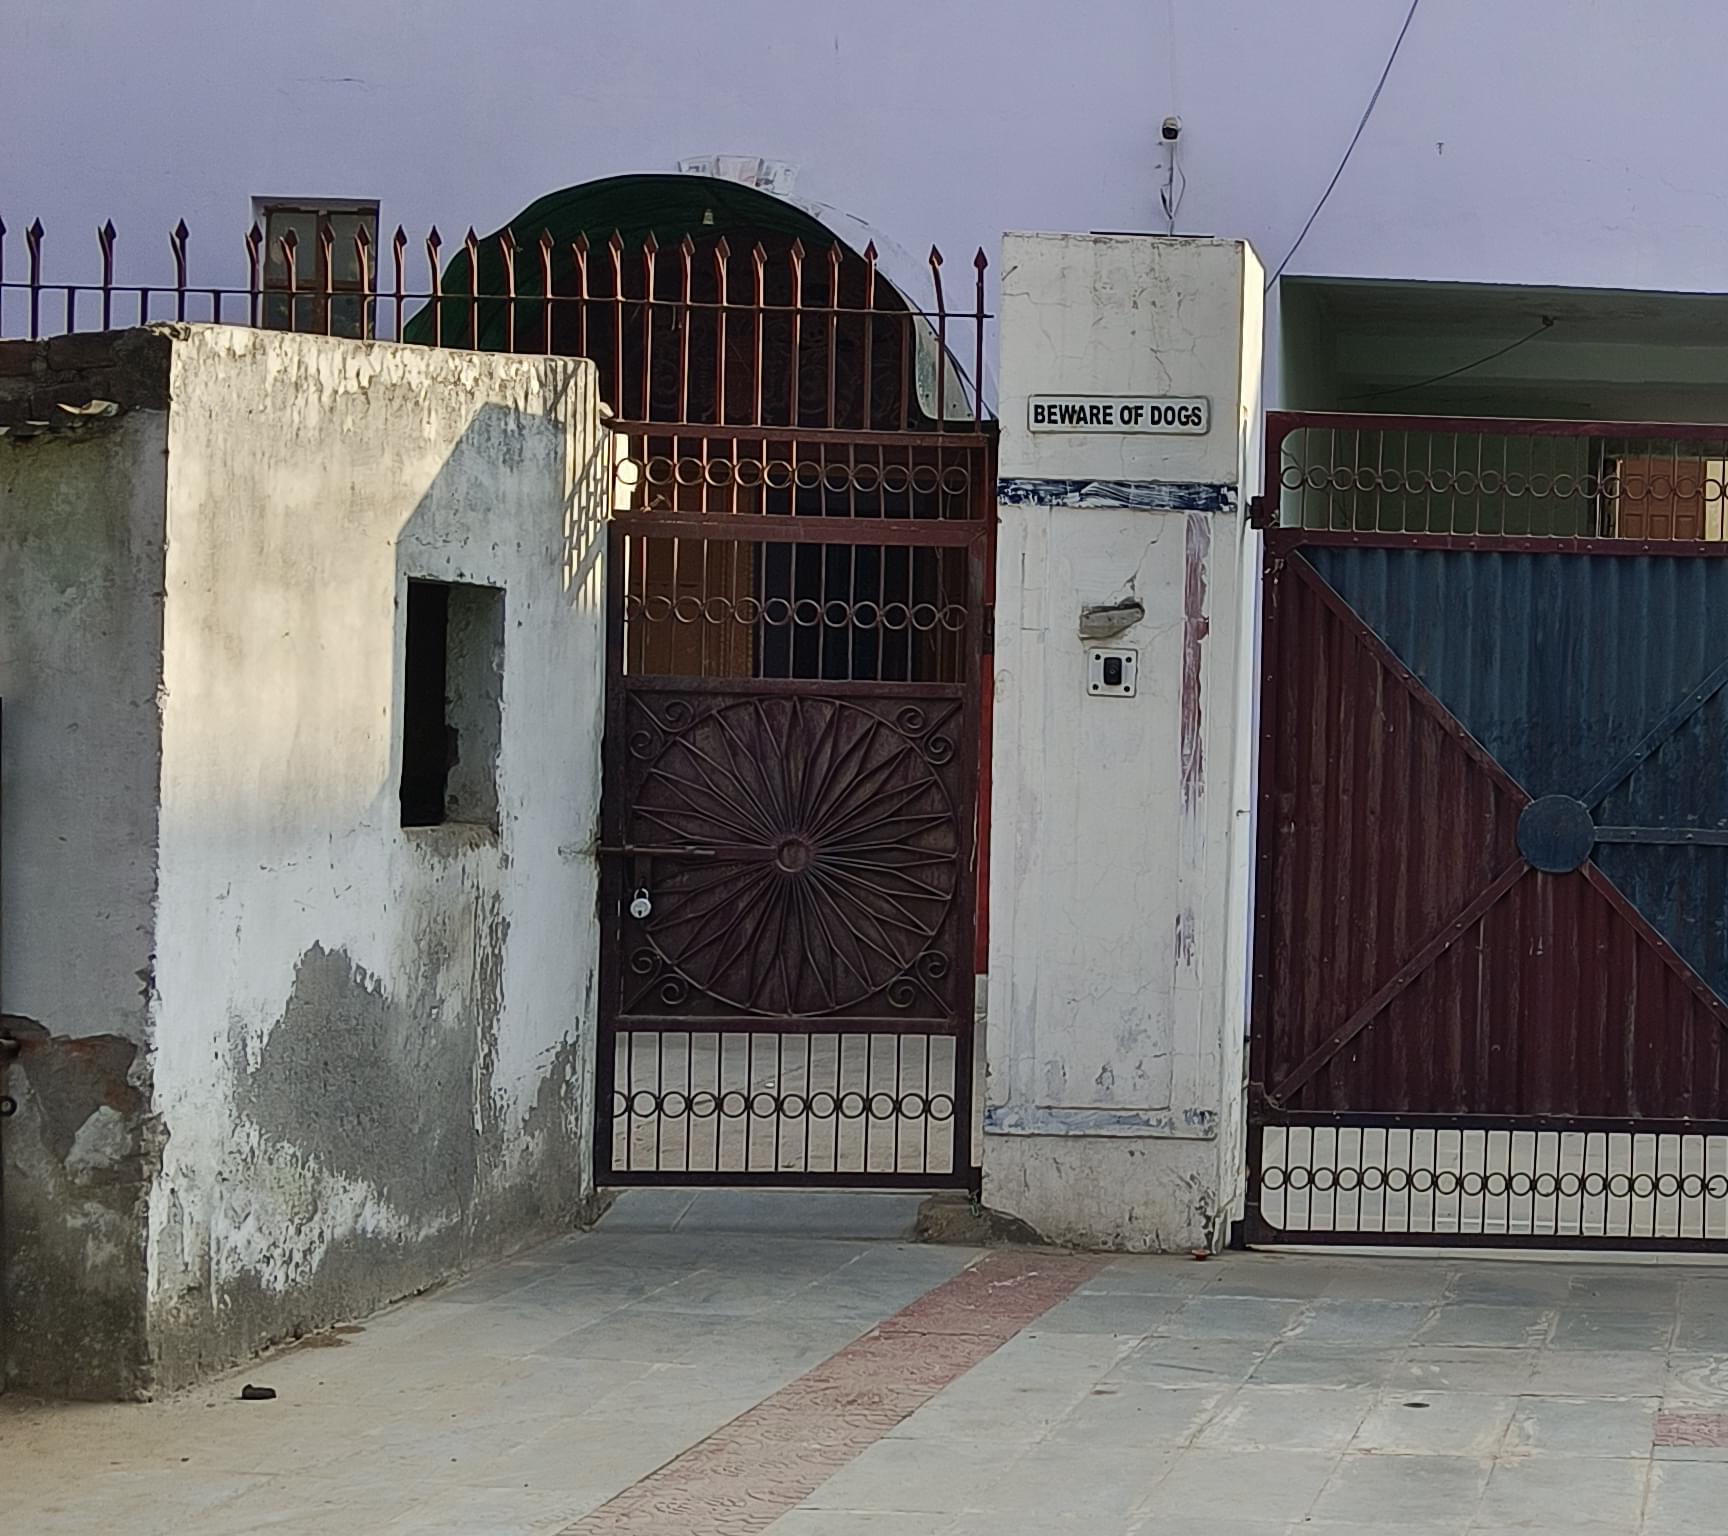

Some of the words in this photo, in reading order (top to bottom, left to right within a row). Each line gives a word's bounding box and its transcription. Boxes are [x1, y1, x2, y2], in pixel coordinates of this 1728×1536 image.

[1033, 404, 1114, 425] BEWARE
[1119, 405, 1144, 426] OF
[1150, 405, 1202, 426] DOGS
